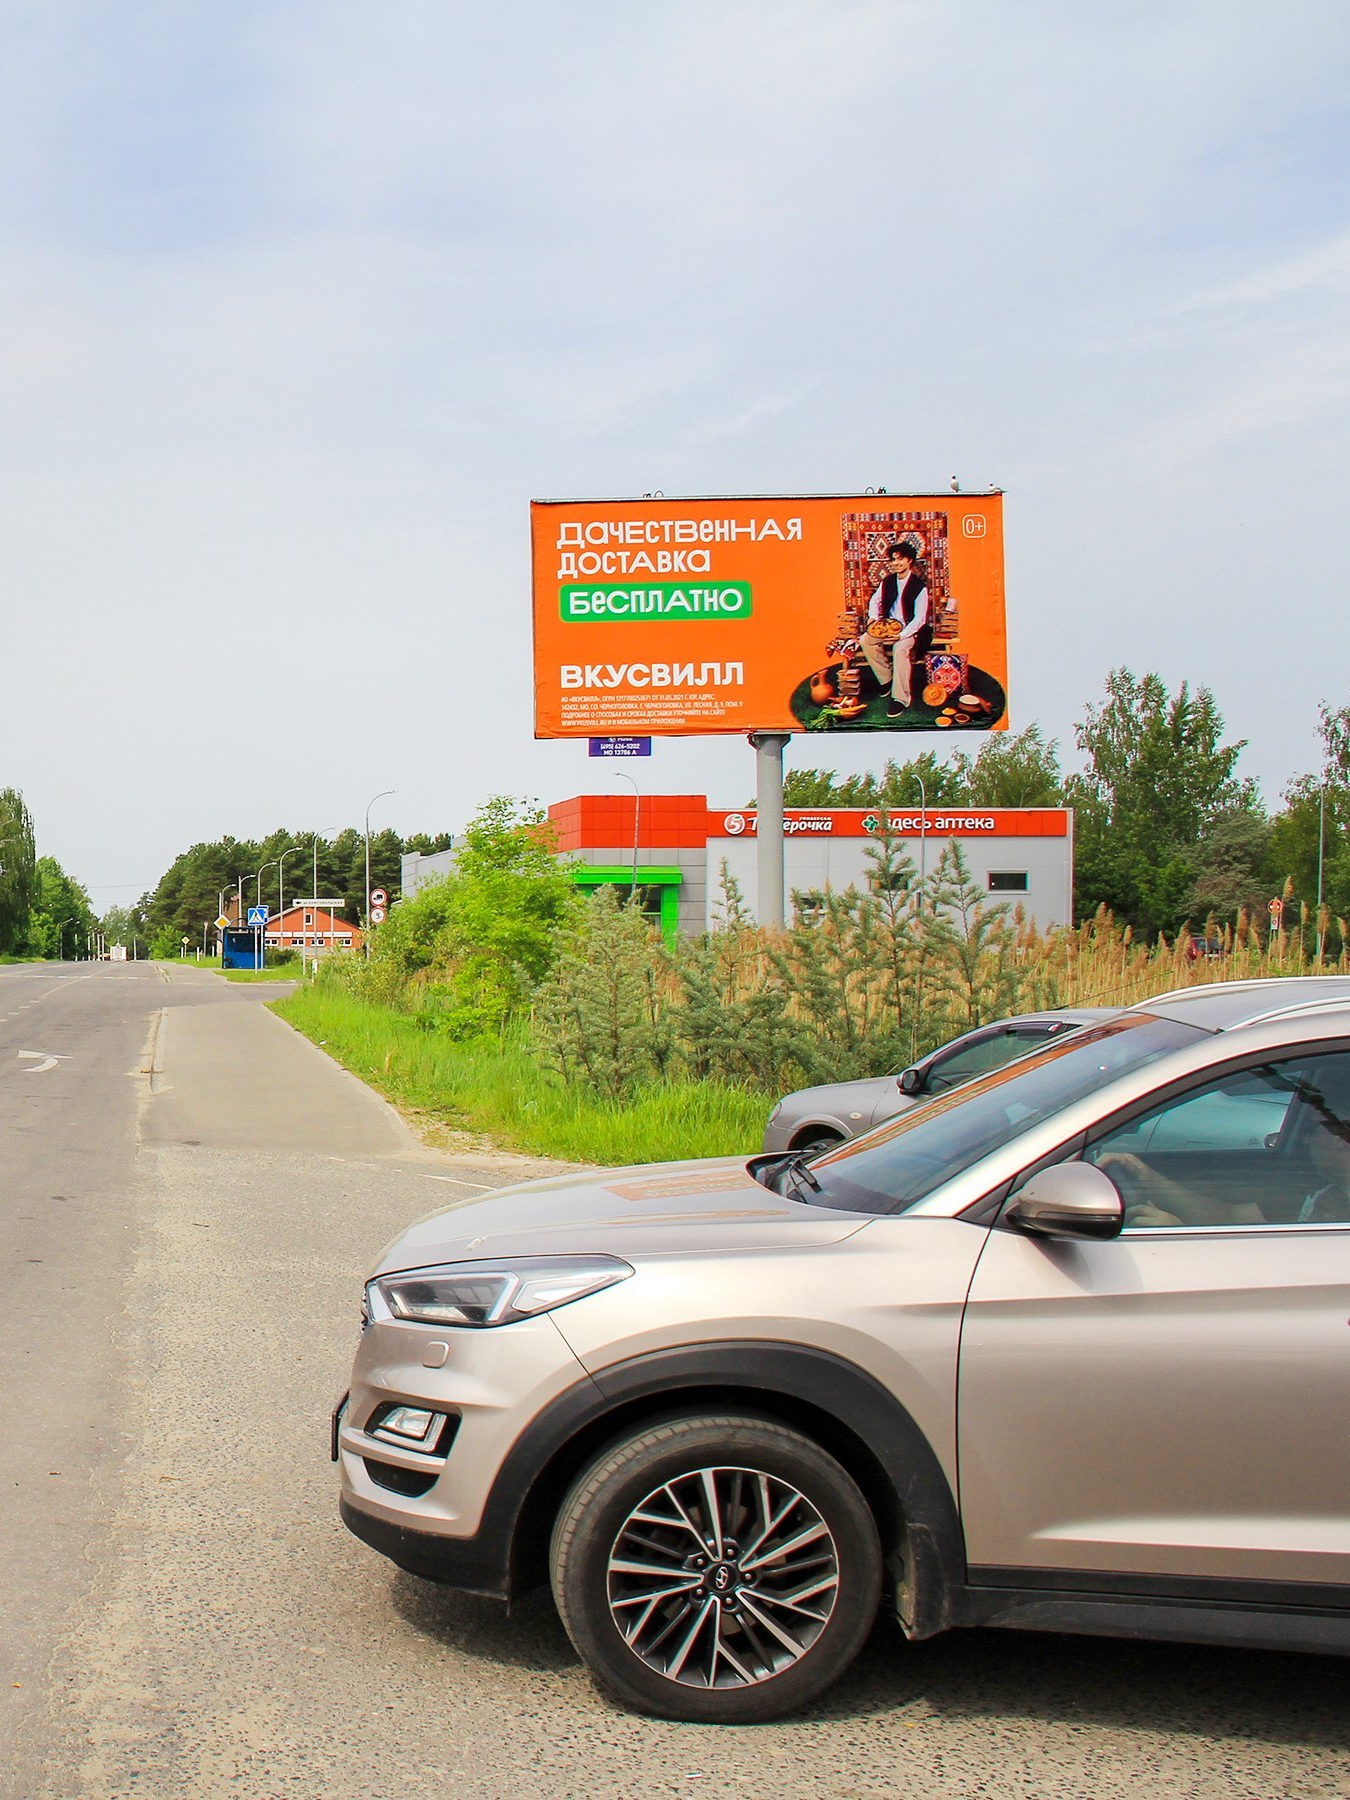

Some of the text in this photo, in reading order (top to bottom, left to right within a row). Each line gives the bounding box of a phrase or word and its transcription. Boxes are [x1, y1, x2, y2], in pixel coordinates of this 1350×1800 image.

[965, 518, 984, 535] 0+
[560, 662, 744, 688] ВКУСВИЛЛ
[935, 817, 995, 829] аптека
